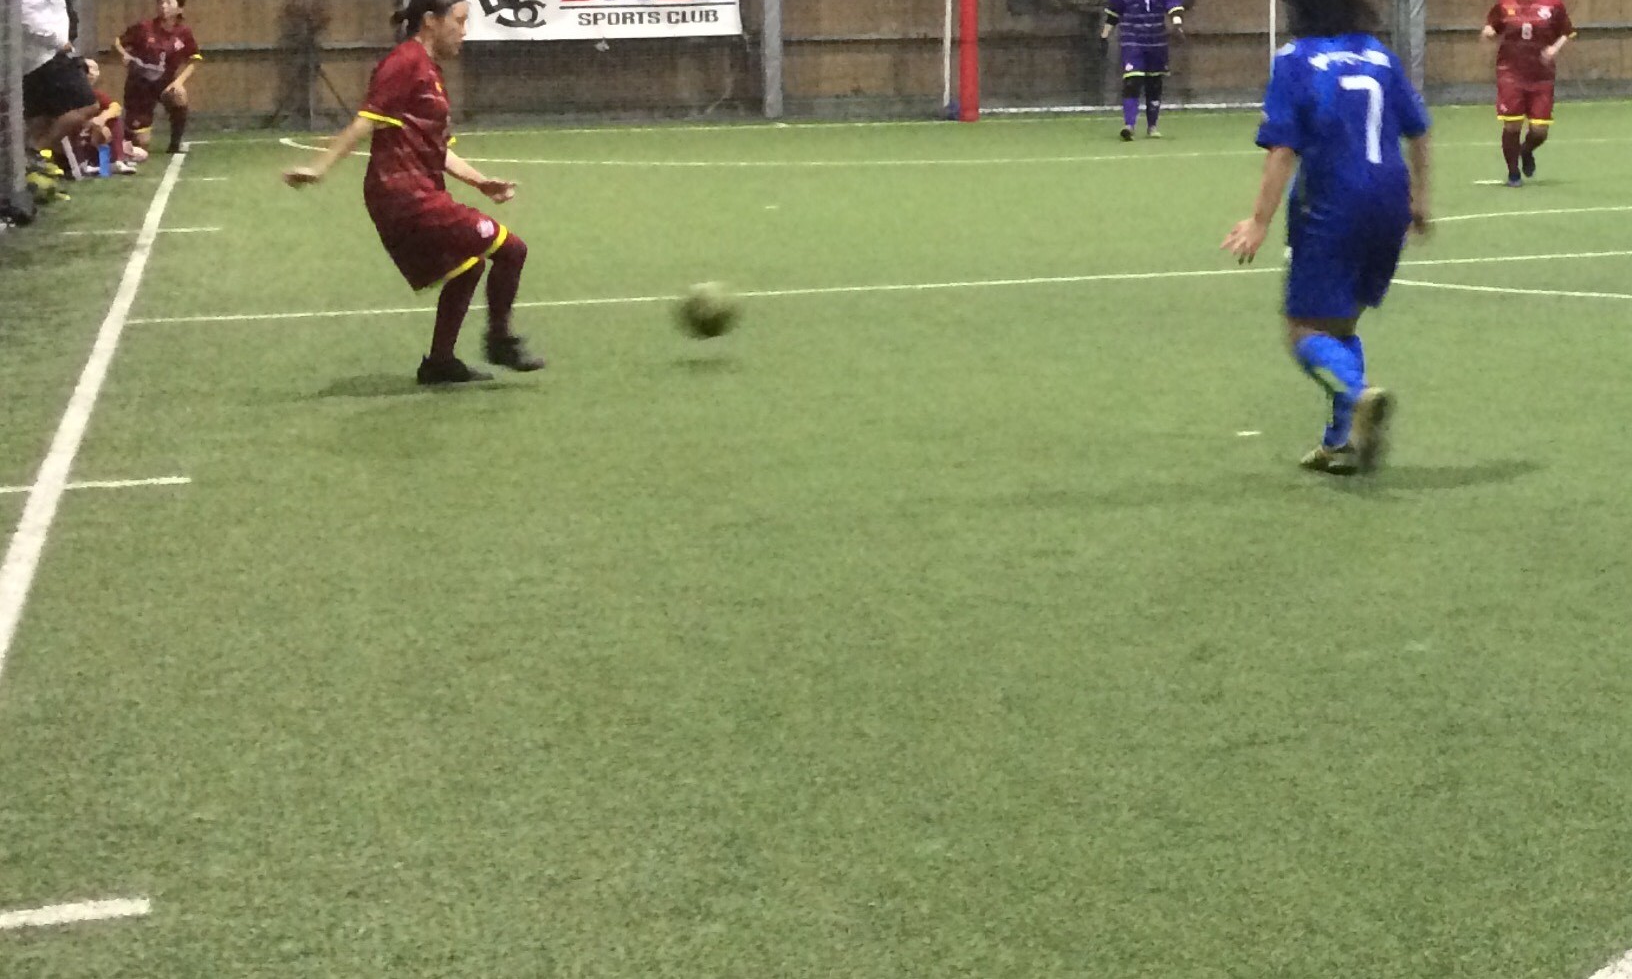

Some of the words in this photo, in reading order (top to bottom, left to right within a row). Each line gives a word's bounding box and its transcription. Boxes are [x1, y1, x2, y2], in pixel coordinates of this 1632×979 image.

[577, 11, 661, 26] SPORTS
[666, 9, 719, 24] CLUB
[1338, 75, 1384, 164] 7
